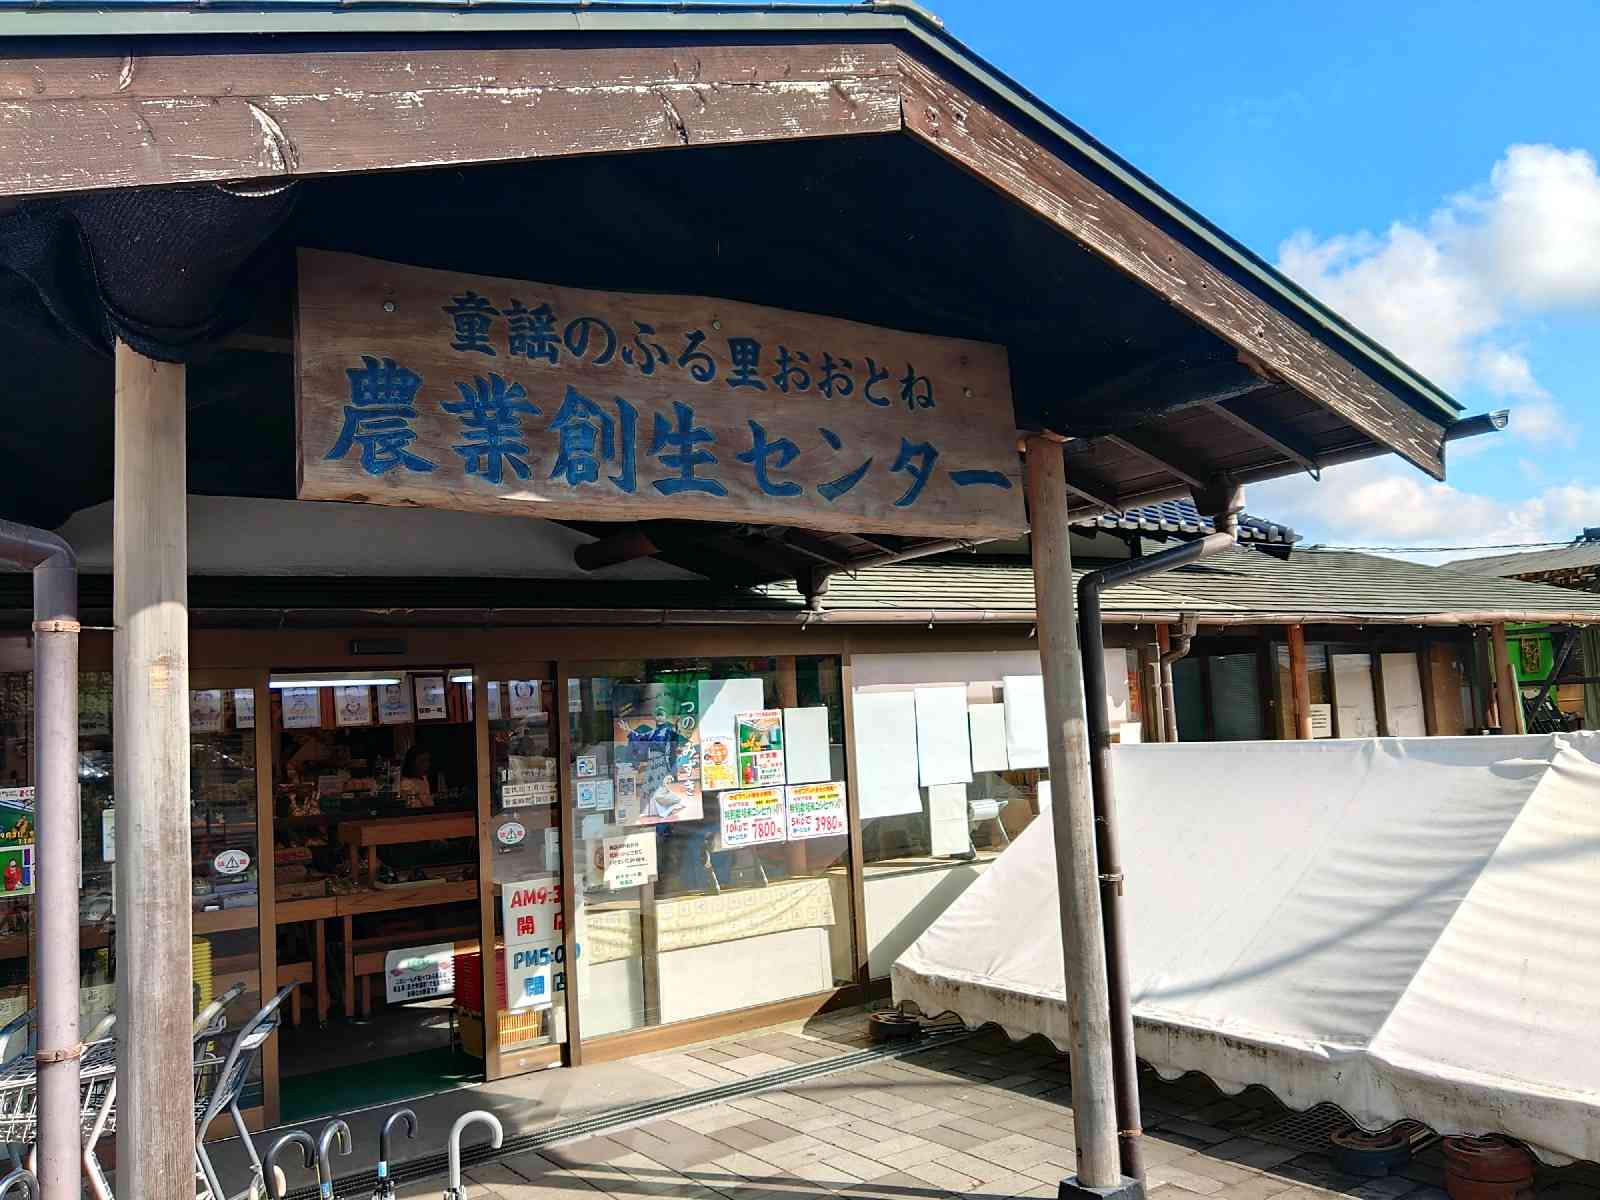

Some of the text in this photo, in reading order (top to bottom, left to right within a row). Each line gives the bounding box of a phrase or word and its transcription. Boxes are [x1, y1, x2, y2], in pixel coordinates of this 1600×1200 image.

[442, 291, 935, 410] 童謡のふる里おおとね
[324, 355, 1012, 507] 農業創生センター
